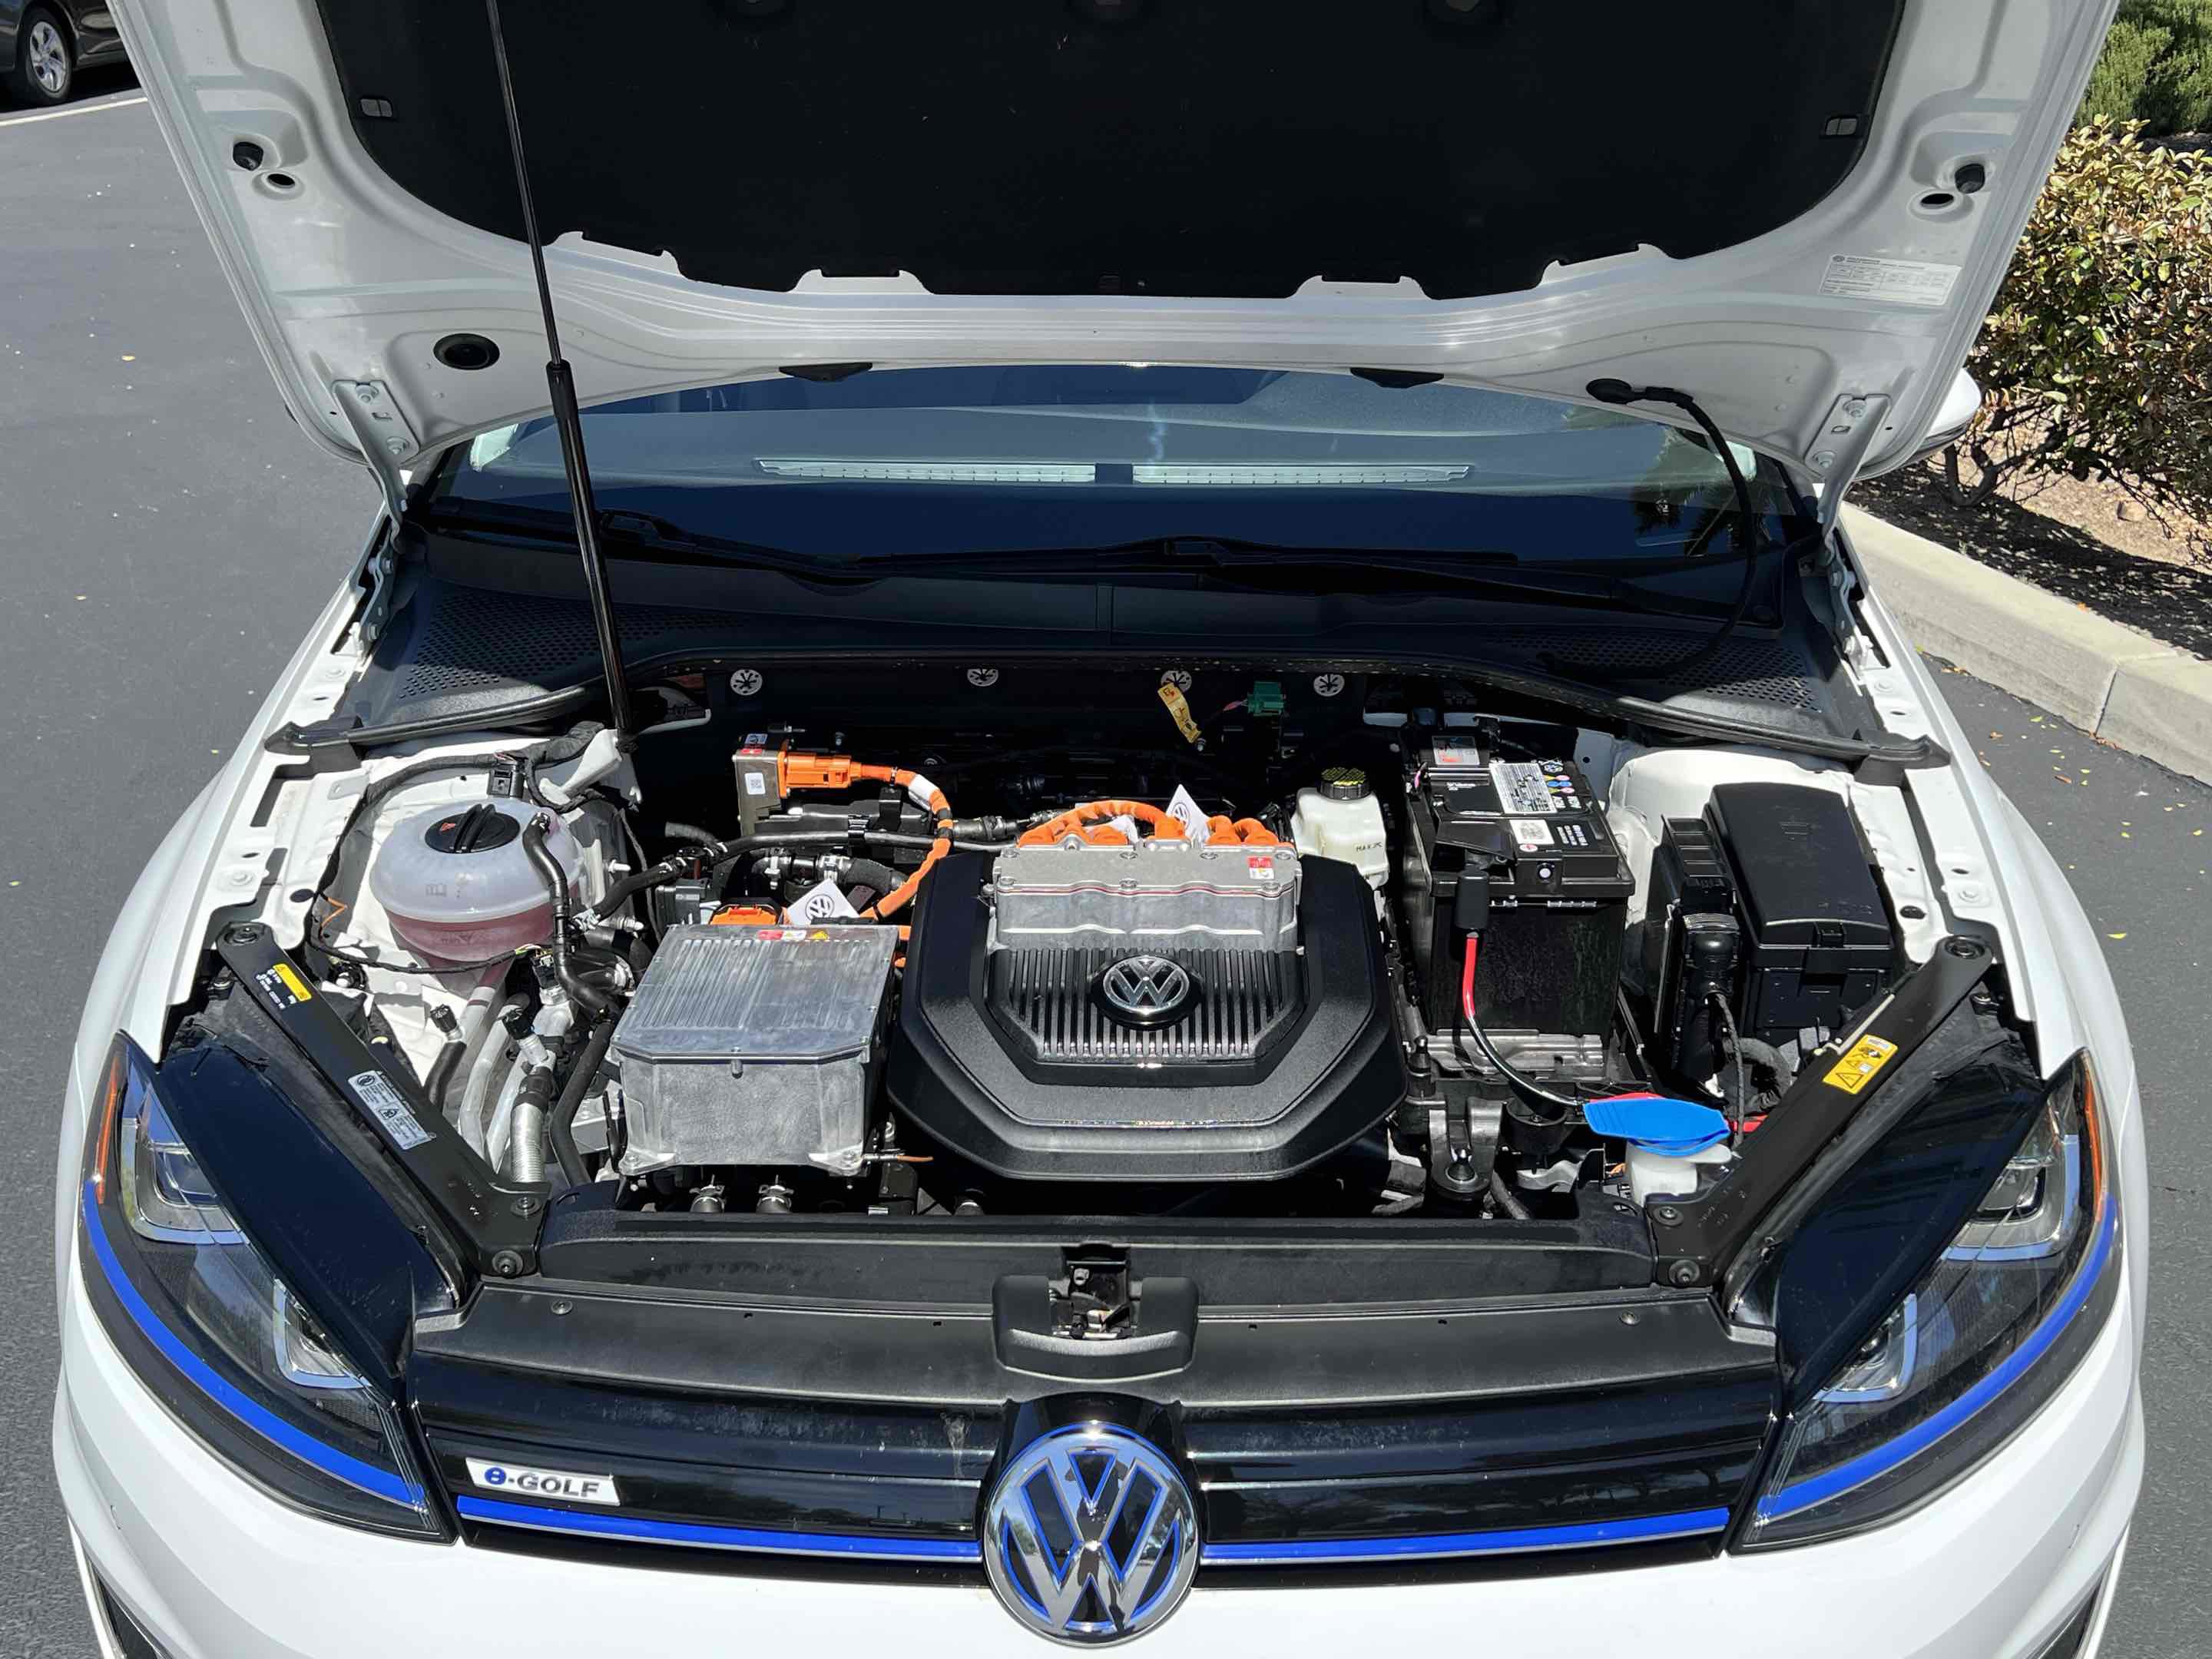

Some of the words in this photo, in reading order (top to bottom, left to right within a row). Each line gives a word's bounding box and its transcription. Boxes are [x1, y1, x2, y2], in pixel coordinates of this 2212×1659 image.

[1104, 956, 1189, 1014] VW
[484, 1466, 600, 1497] e-GOLF
[985, 1422, 1197, 1648] VW
